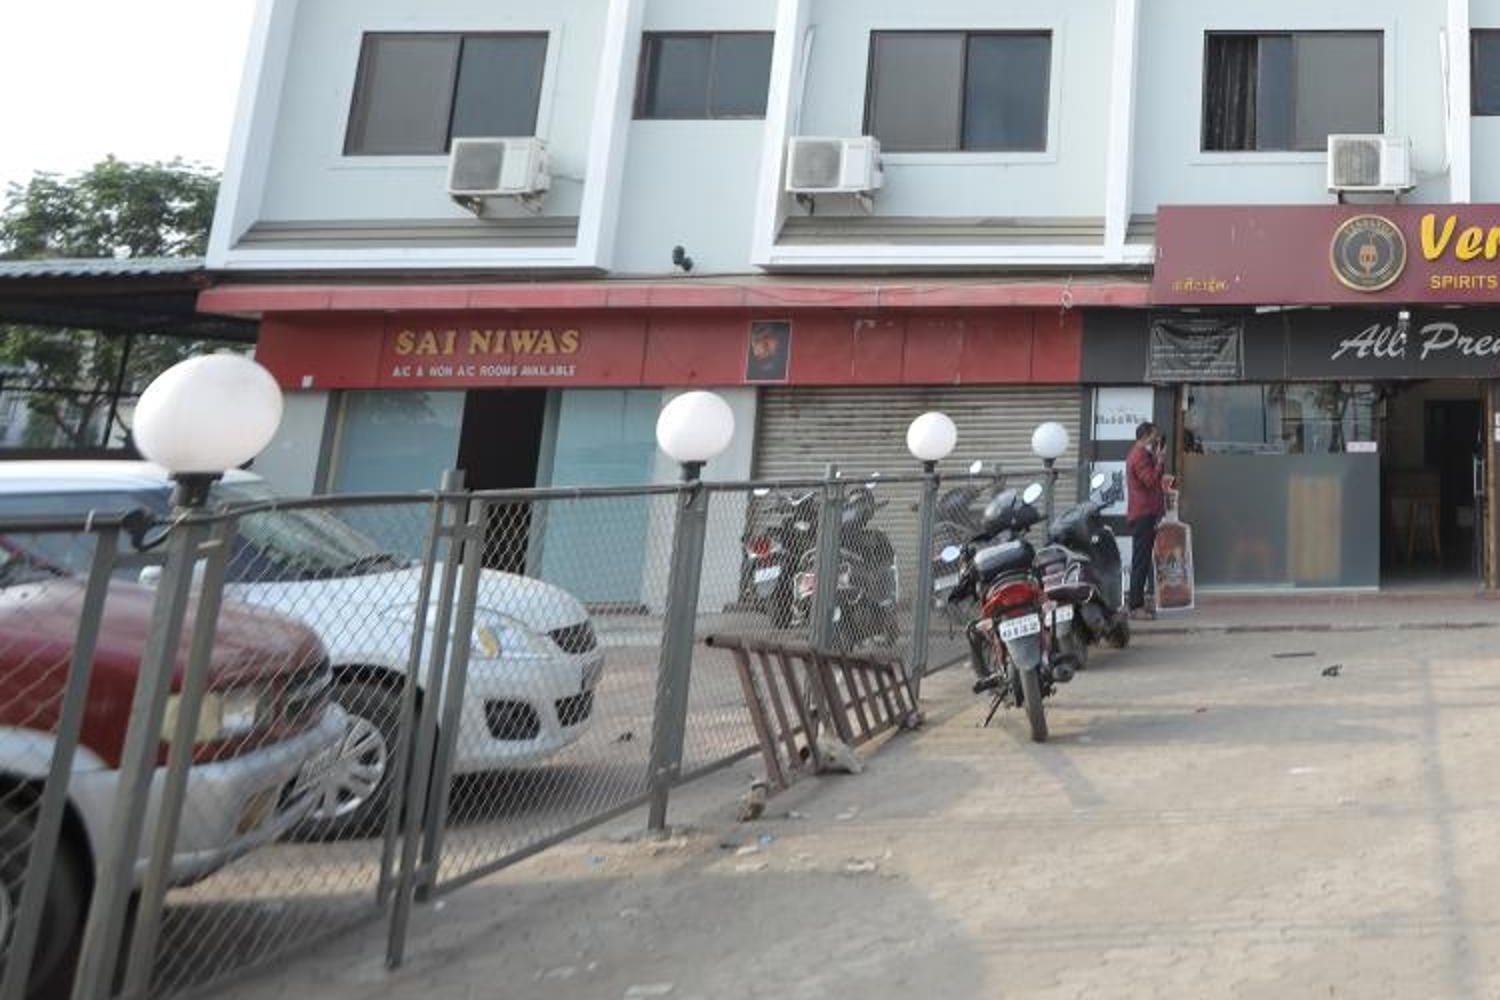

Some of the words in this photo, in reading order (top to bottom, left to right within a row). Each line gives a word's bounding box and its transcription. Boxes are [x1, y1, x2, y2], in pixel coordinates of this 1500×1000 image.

[1430, 275, 1498, 290] SPIRITS
[394, 328, 457, 355] SAI
[468, 328, 579, 355] NIWAS
[1331, 323, 1403, 361] All
[429, 365, 453, 377] NON
[480, 365, 520, 377] ROOMS
[520, 365, 577, 377] AVAILABLE
